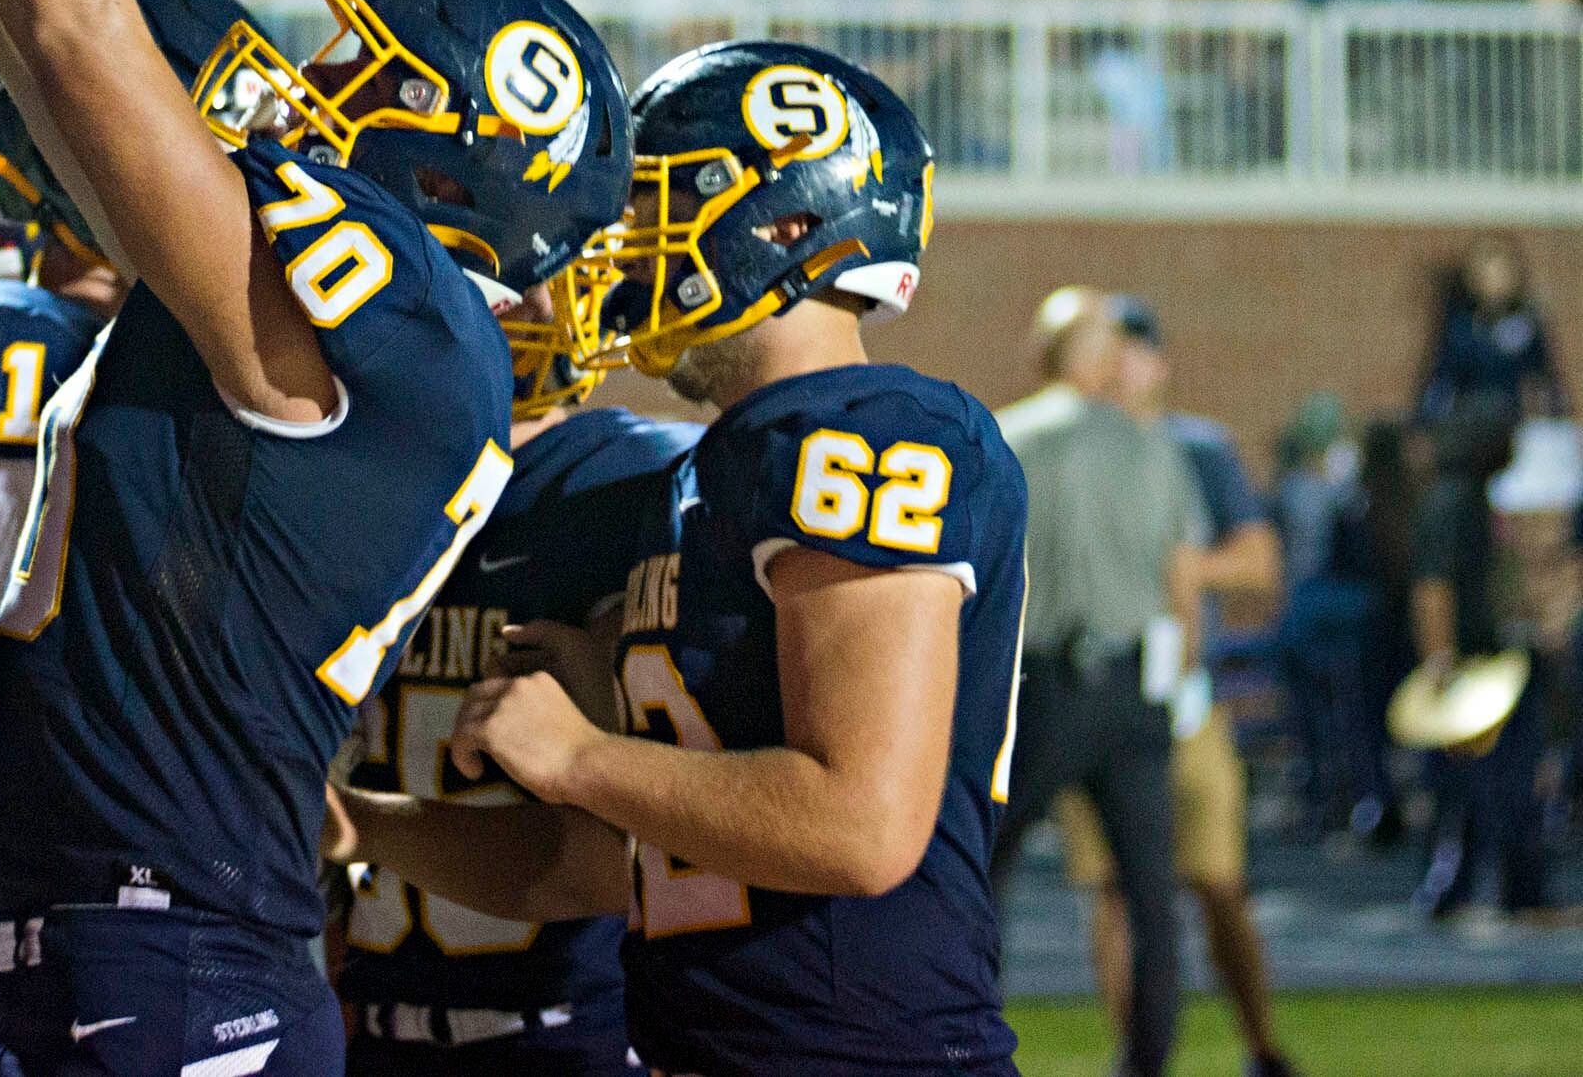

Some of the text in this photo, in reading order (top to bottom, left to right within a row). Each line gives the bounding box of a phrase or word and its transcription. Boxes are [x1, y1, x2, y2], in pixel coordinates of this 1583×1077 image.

[504, 38, 570, 114] S
[769, 79, 829, 137] S
[257, 160, 393, 328] 70
[790, 428, 953, 554] 62
